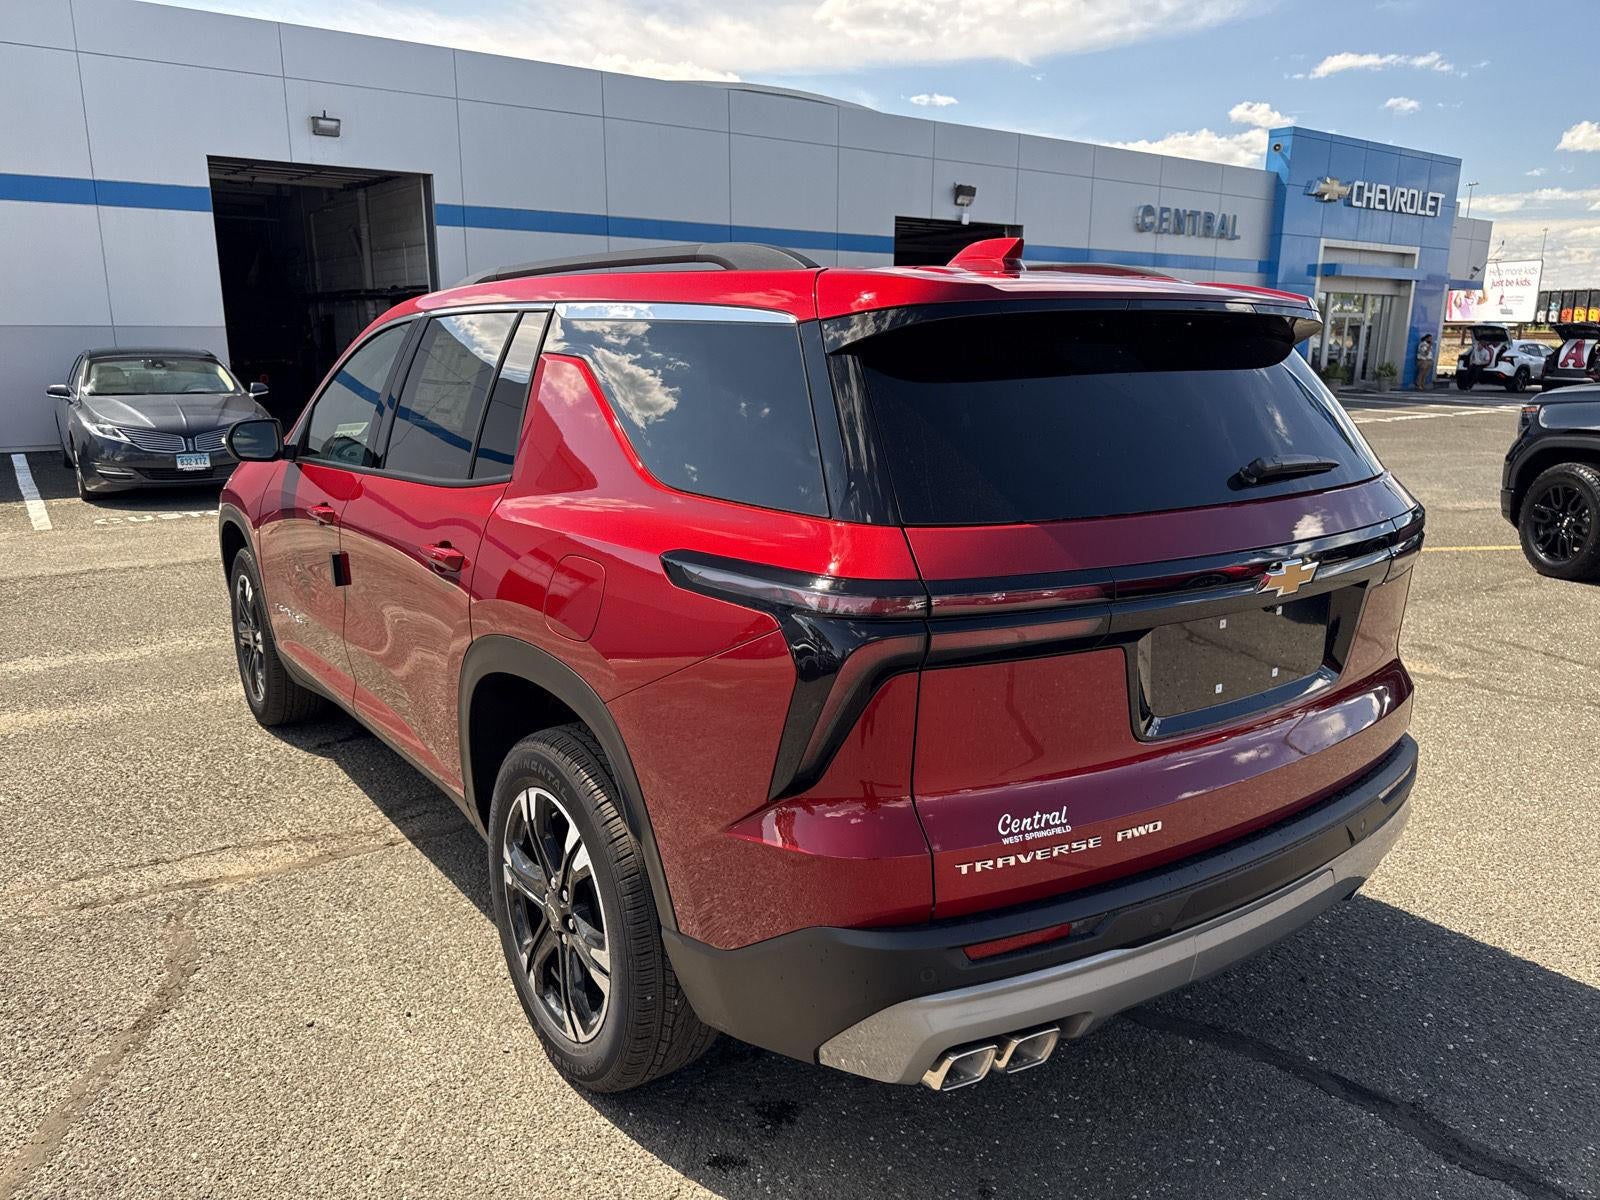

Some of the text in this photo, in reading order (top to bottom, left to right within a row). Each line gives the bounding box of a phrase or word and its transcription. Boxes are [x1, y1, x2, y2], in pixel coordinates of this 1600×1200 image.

[1351, 180, 1446, 217] CHEVROLET
[1135, 204, 1241, 240] CENTRAL
[1491, 279, 1503, 289] just
[1505, 278, 1515, 287] be
[1524, 267, 1538, 276] kids
[1560, 340, 1585, 368] A
[998, 806, 1068, 835] Central
[955, 820, 1163, 875] TRAVERSE AWD
[1002, 825, 1071, 845] WEST SPRINGFIELD
